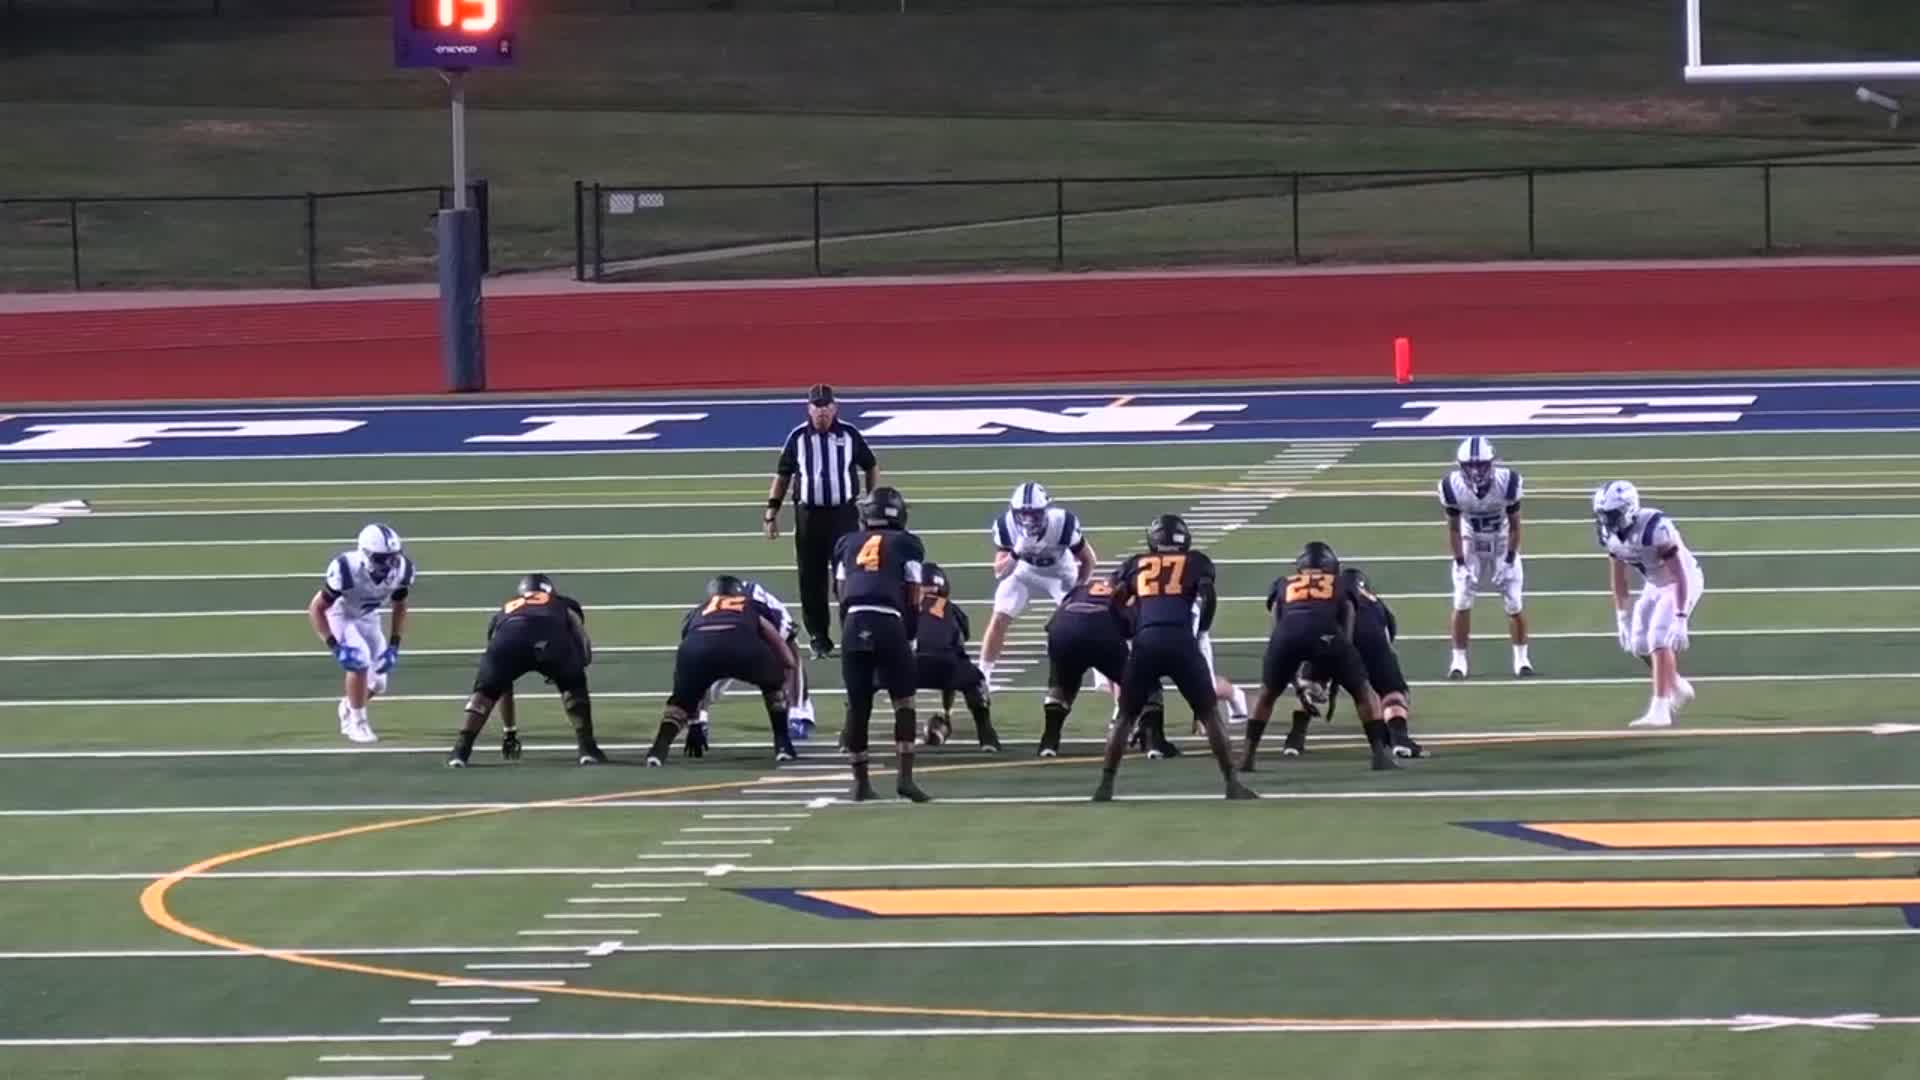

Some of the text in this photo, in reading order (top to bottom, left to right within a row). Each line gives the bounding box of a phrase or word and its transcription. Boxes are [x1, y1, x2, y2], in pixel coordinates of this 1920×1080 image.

[0, 394, 1758, 451] PINE
[1469, 513, 1501, 534] 15
[855, 534, 882, 571] 4
[1136, 554, 1187, 597] 27
[1285, 573, 1335, 603] 23
